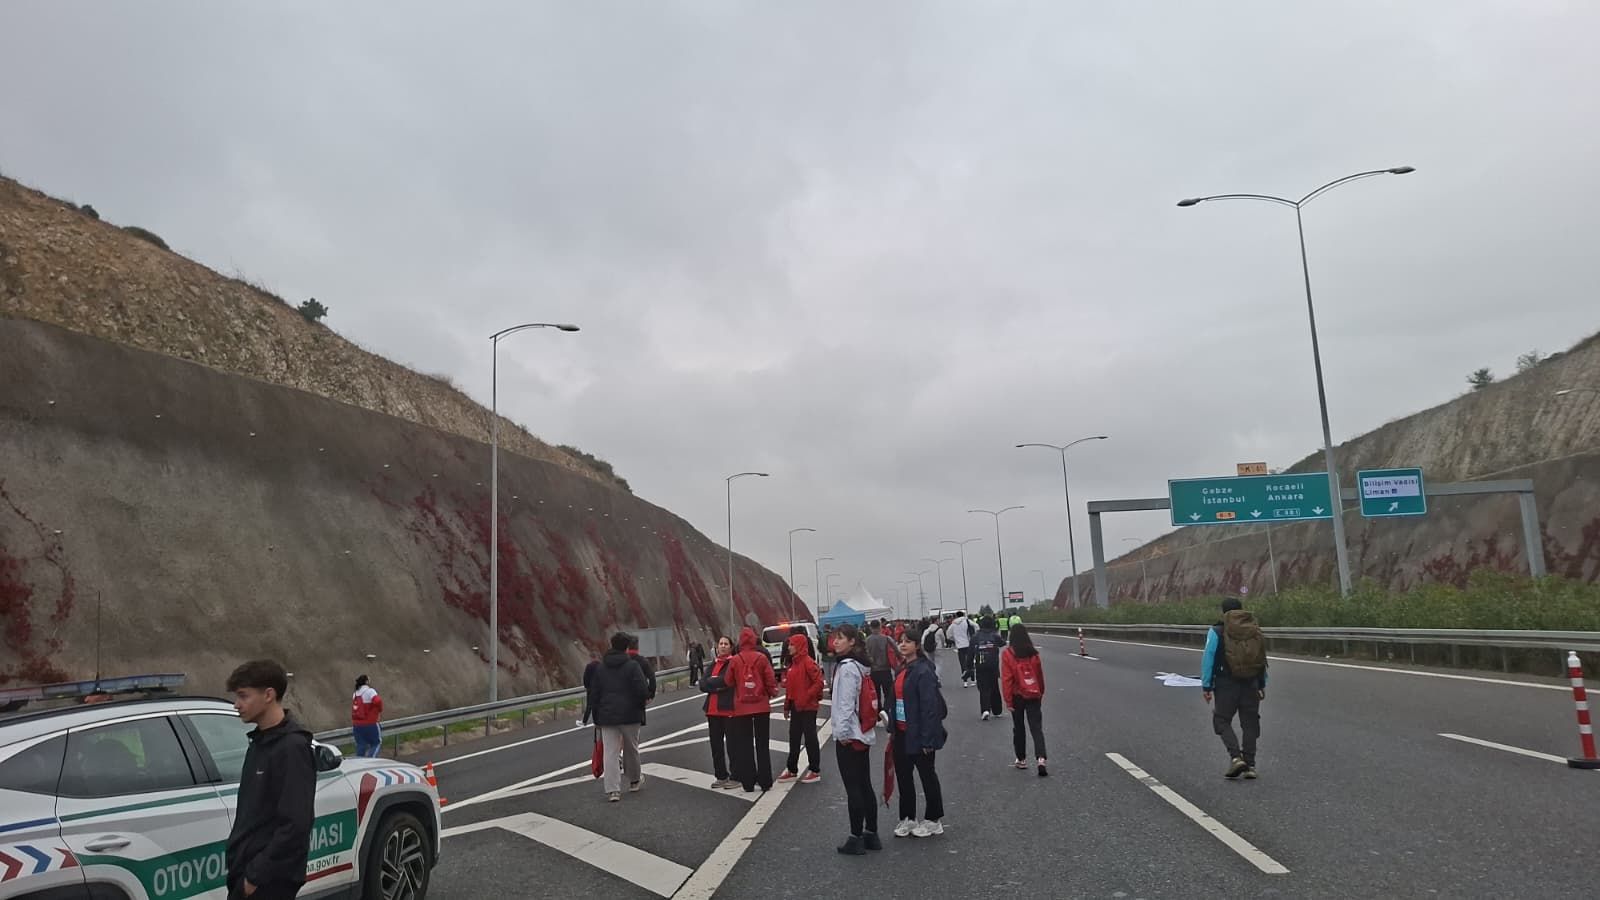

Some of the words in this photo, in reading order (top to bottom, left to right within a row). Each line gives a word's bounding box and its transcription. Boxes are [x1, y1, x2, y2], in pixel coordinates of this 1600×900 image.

[1202, 487, 1233, 495] Gebze
[1265, 483, 1304, 492] Kocaeli
[1268, 493, 1304, 501] Ankara
[153, 851, 229, 896] OTOYOL
[309, 821, 343, 852] MASI
